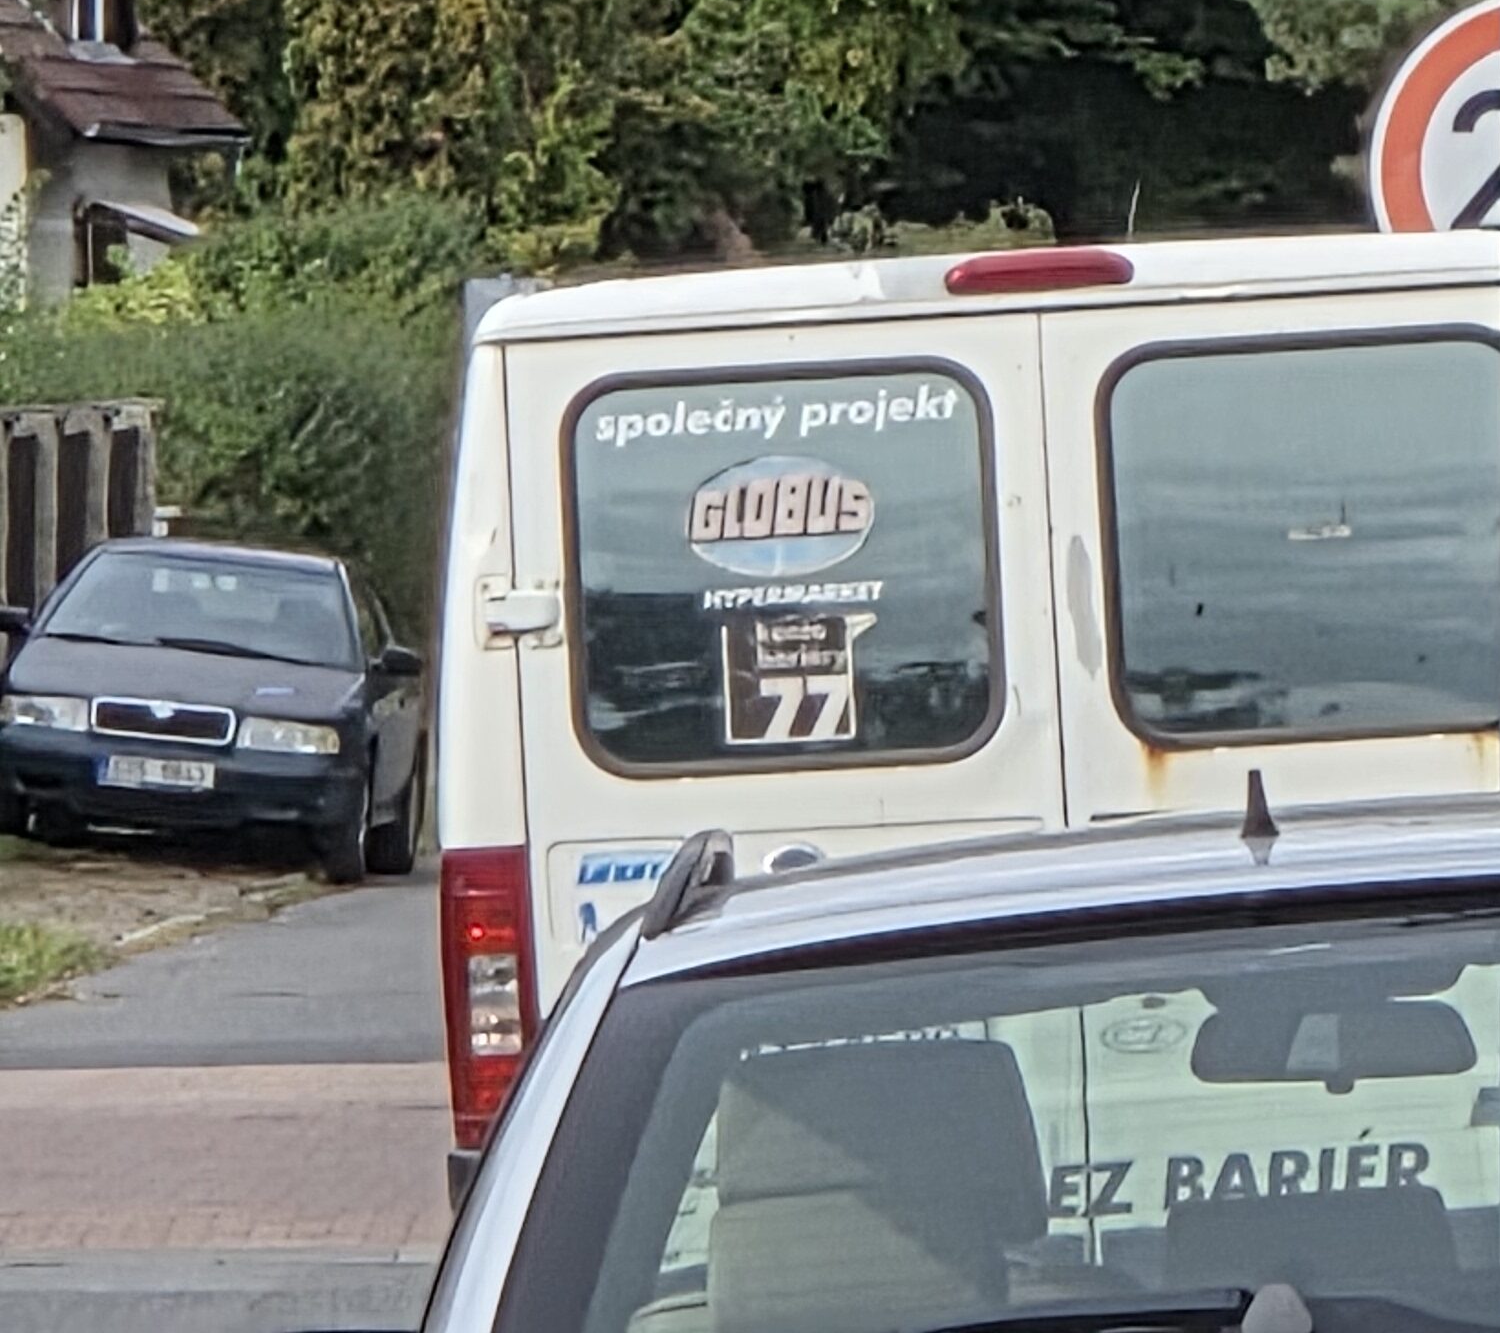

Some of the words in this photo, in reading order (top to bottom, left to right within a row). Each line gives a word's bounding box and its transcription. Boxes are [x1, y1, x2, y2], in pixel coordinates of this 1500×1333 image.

[596, 395, 787, 448] společný
[799, 383, 959, 438] projekt
[689, 474, 870, 542] GLOBUS
[1050, 1160, 1134, 1218] EZ
